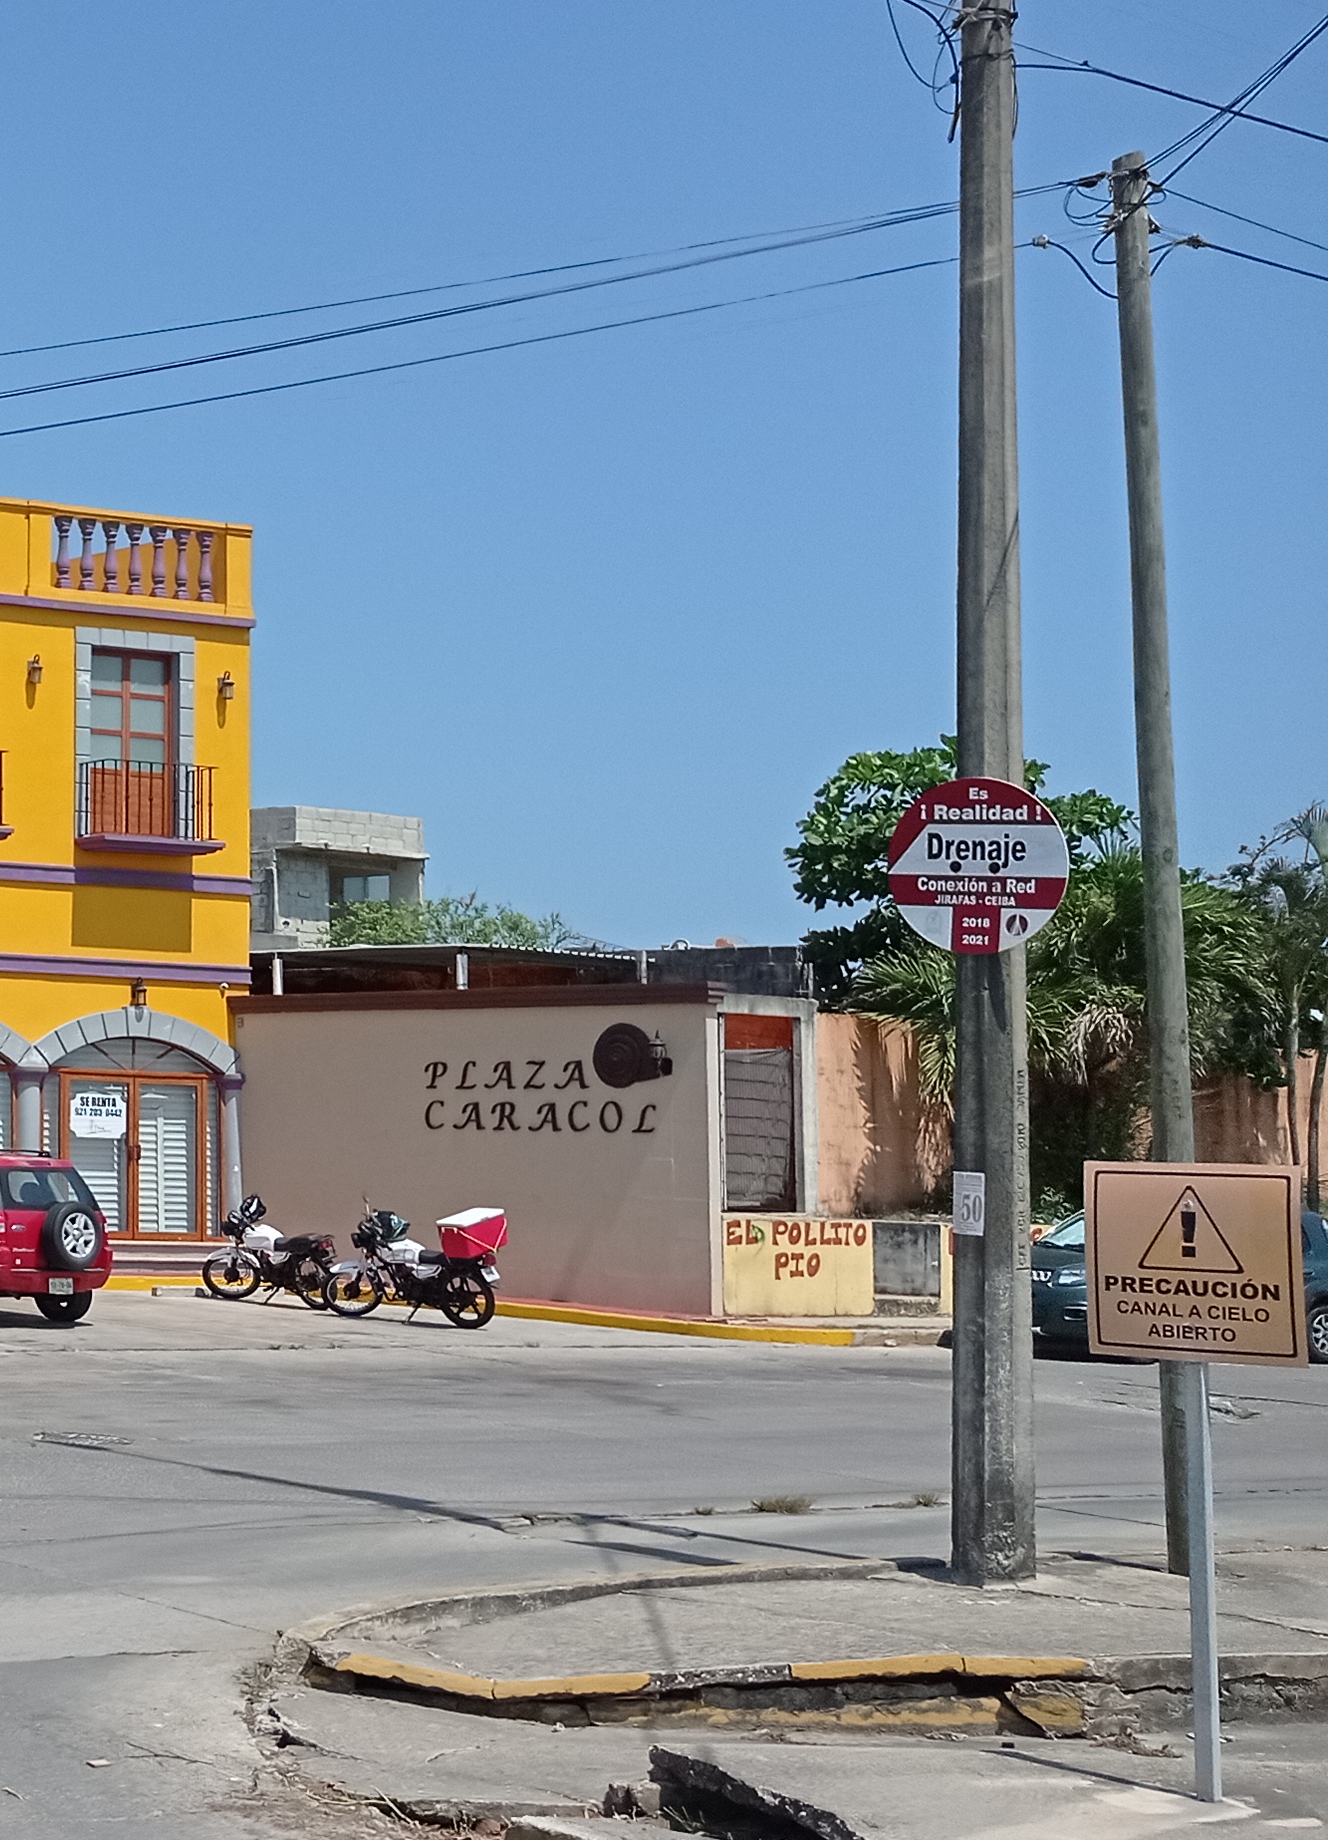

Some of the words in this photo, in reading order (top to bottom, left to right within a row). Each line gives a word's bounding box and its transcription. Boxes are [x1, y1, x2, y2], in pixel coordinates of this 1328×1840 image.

[968, 787, 989, 800] Es
[933, 804, 1028, 821] Realidad
[926, 832, 1027, 869] Drenaje
[917, 877, 987, 893] Conexión
[991, 881, 1002, 893] a
[1005, 878, 1036, 894] Red
[934, 894, 976, 905] JIRAFAS
[984, 895, 1016, 906] CEIBA
[961, 917, 990, 928] 2018
[961, 934, 989, 945] 2021
[424, 1059, 590, 1090] PLAZA
[79, 1096, 90, 1107] SE
[91, 1096, 117, 1108] RENTA
[424, 1099, 657, 1133] CARACOL
[961, 1193, 983, 1223] 50
[726, 1219, 757, 1246] EL
[771, 1219, 867, 1247] POLLITO
[774, 1252, 821, 1280] PIO
[1104, 1275, 1281, 1301] PRECAUCIÓN
[1116, 1300, 1184, 1318] CANAL
[1188, 1305, 1202, 1319] A
[1207, 1306, 1270, 1323] CIELO
[1148, 1323, 1237, 1342] ABIERTO
